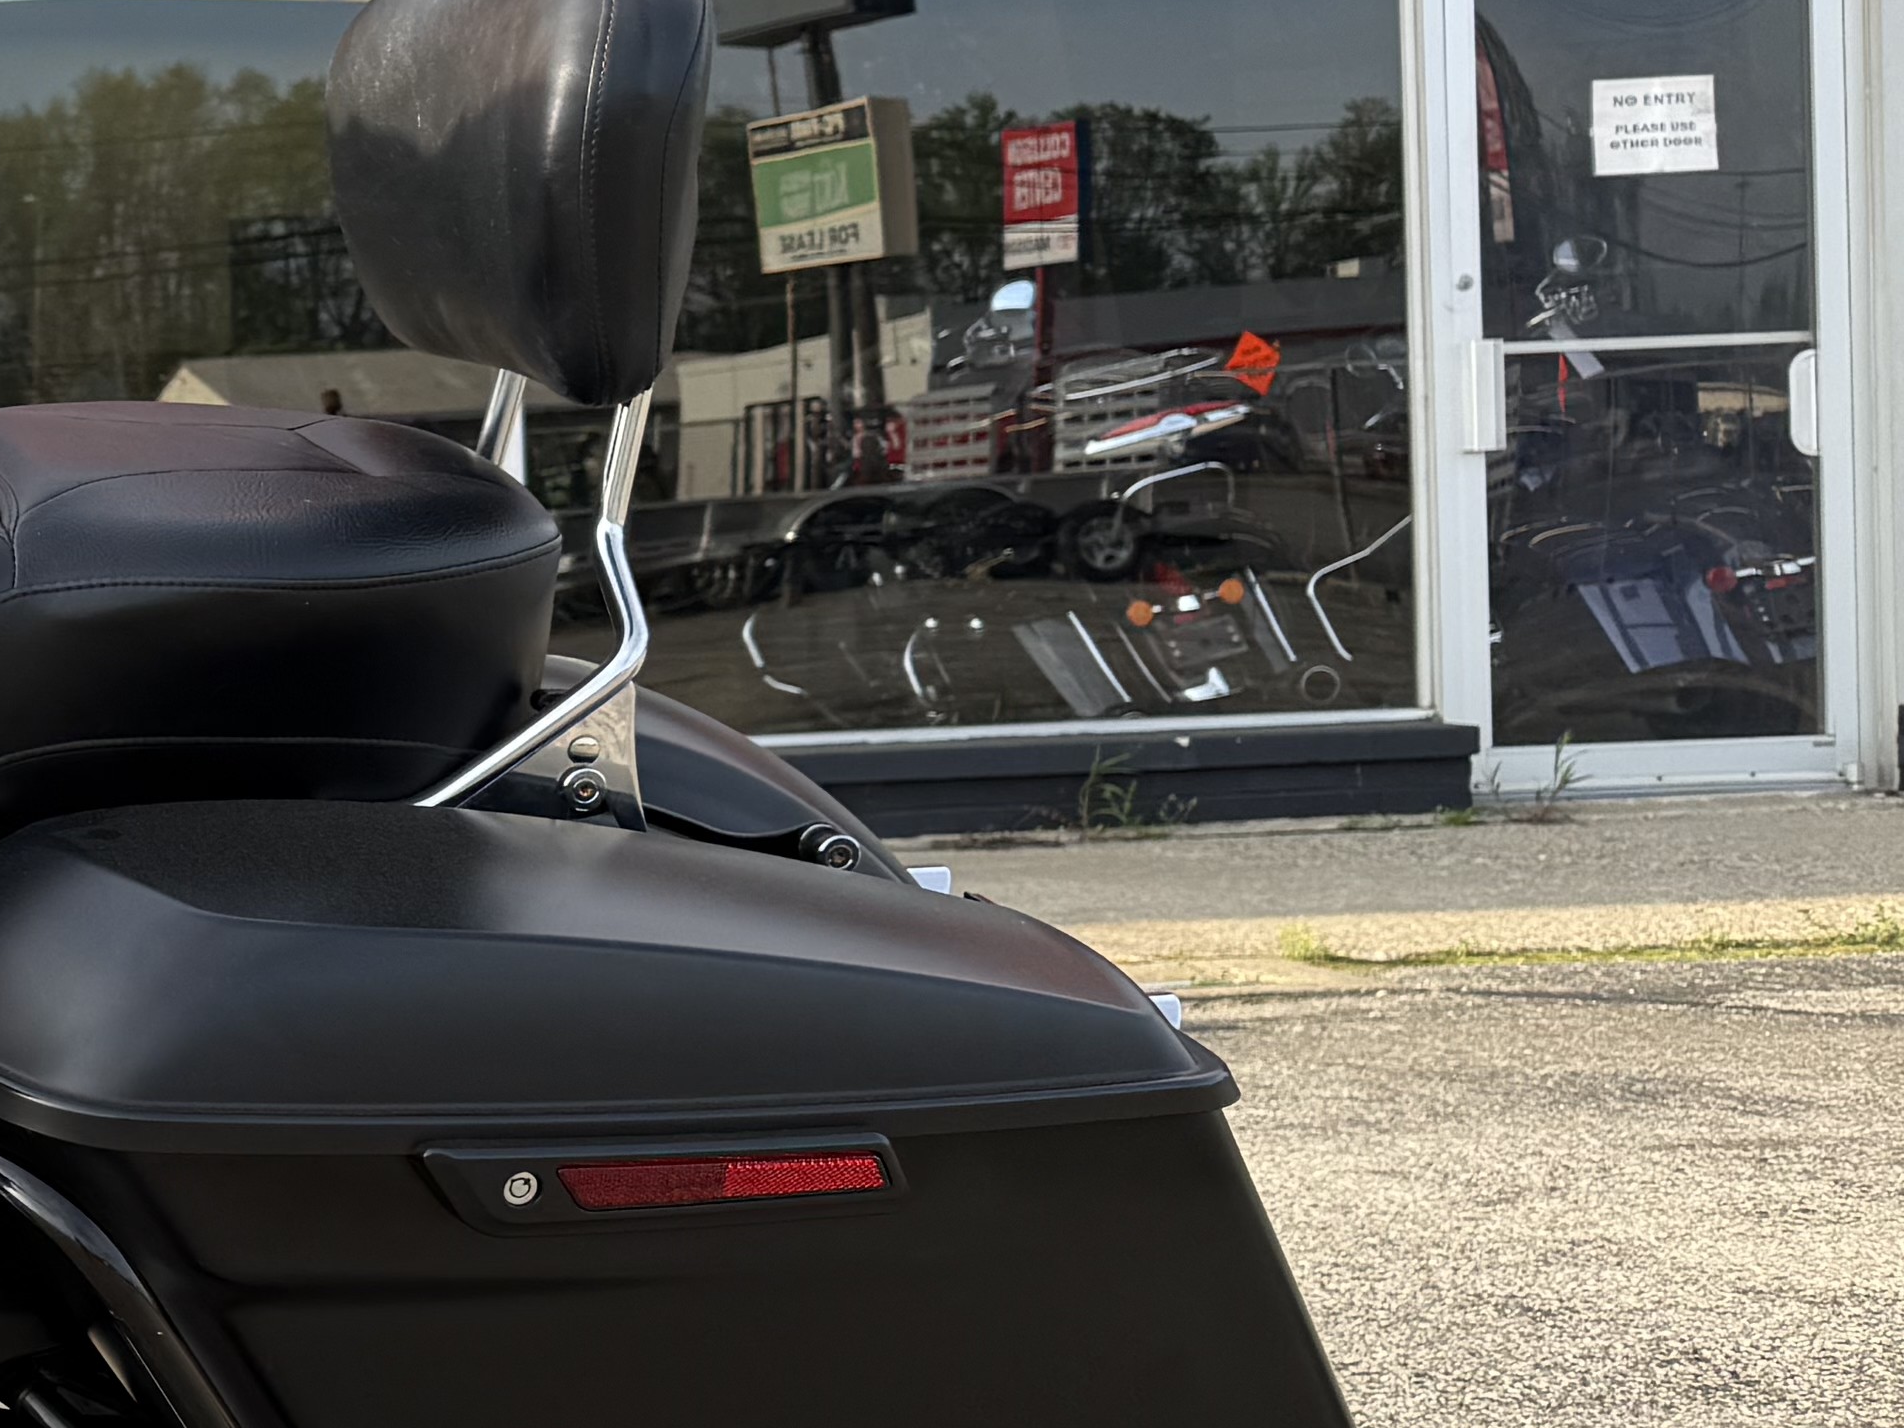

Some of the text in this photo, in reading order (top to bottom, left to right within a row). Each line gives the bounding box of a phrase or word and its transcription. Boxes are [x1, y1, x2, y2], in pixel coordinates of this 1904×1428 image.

[1613, 91, 1696, 107] NO ENTRY
[1615, 122, 1667, 134] PLEASE
[1663, 136, 1703, 148] DOOR
